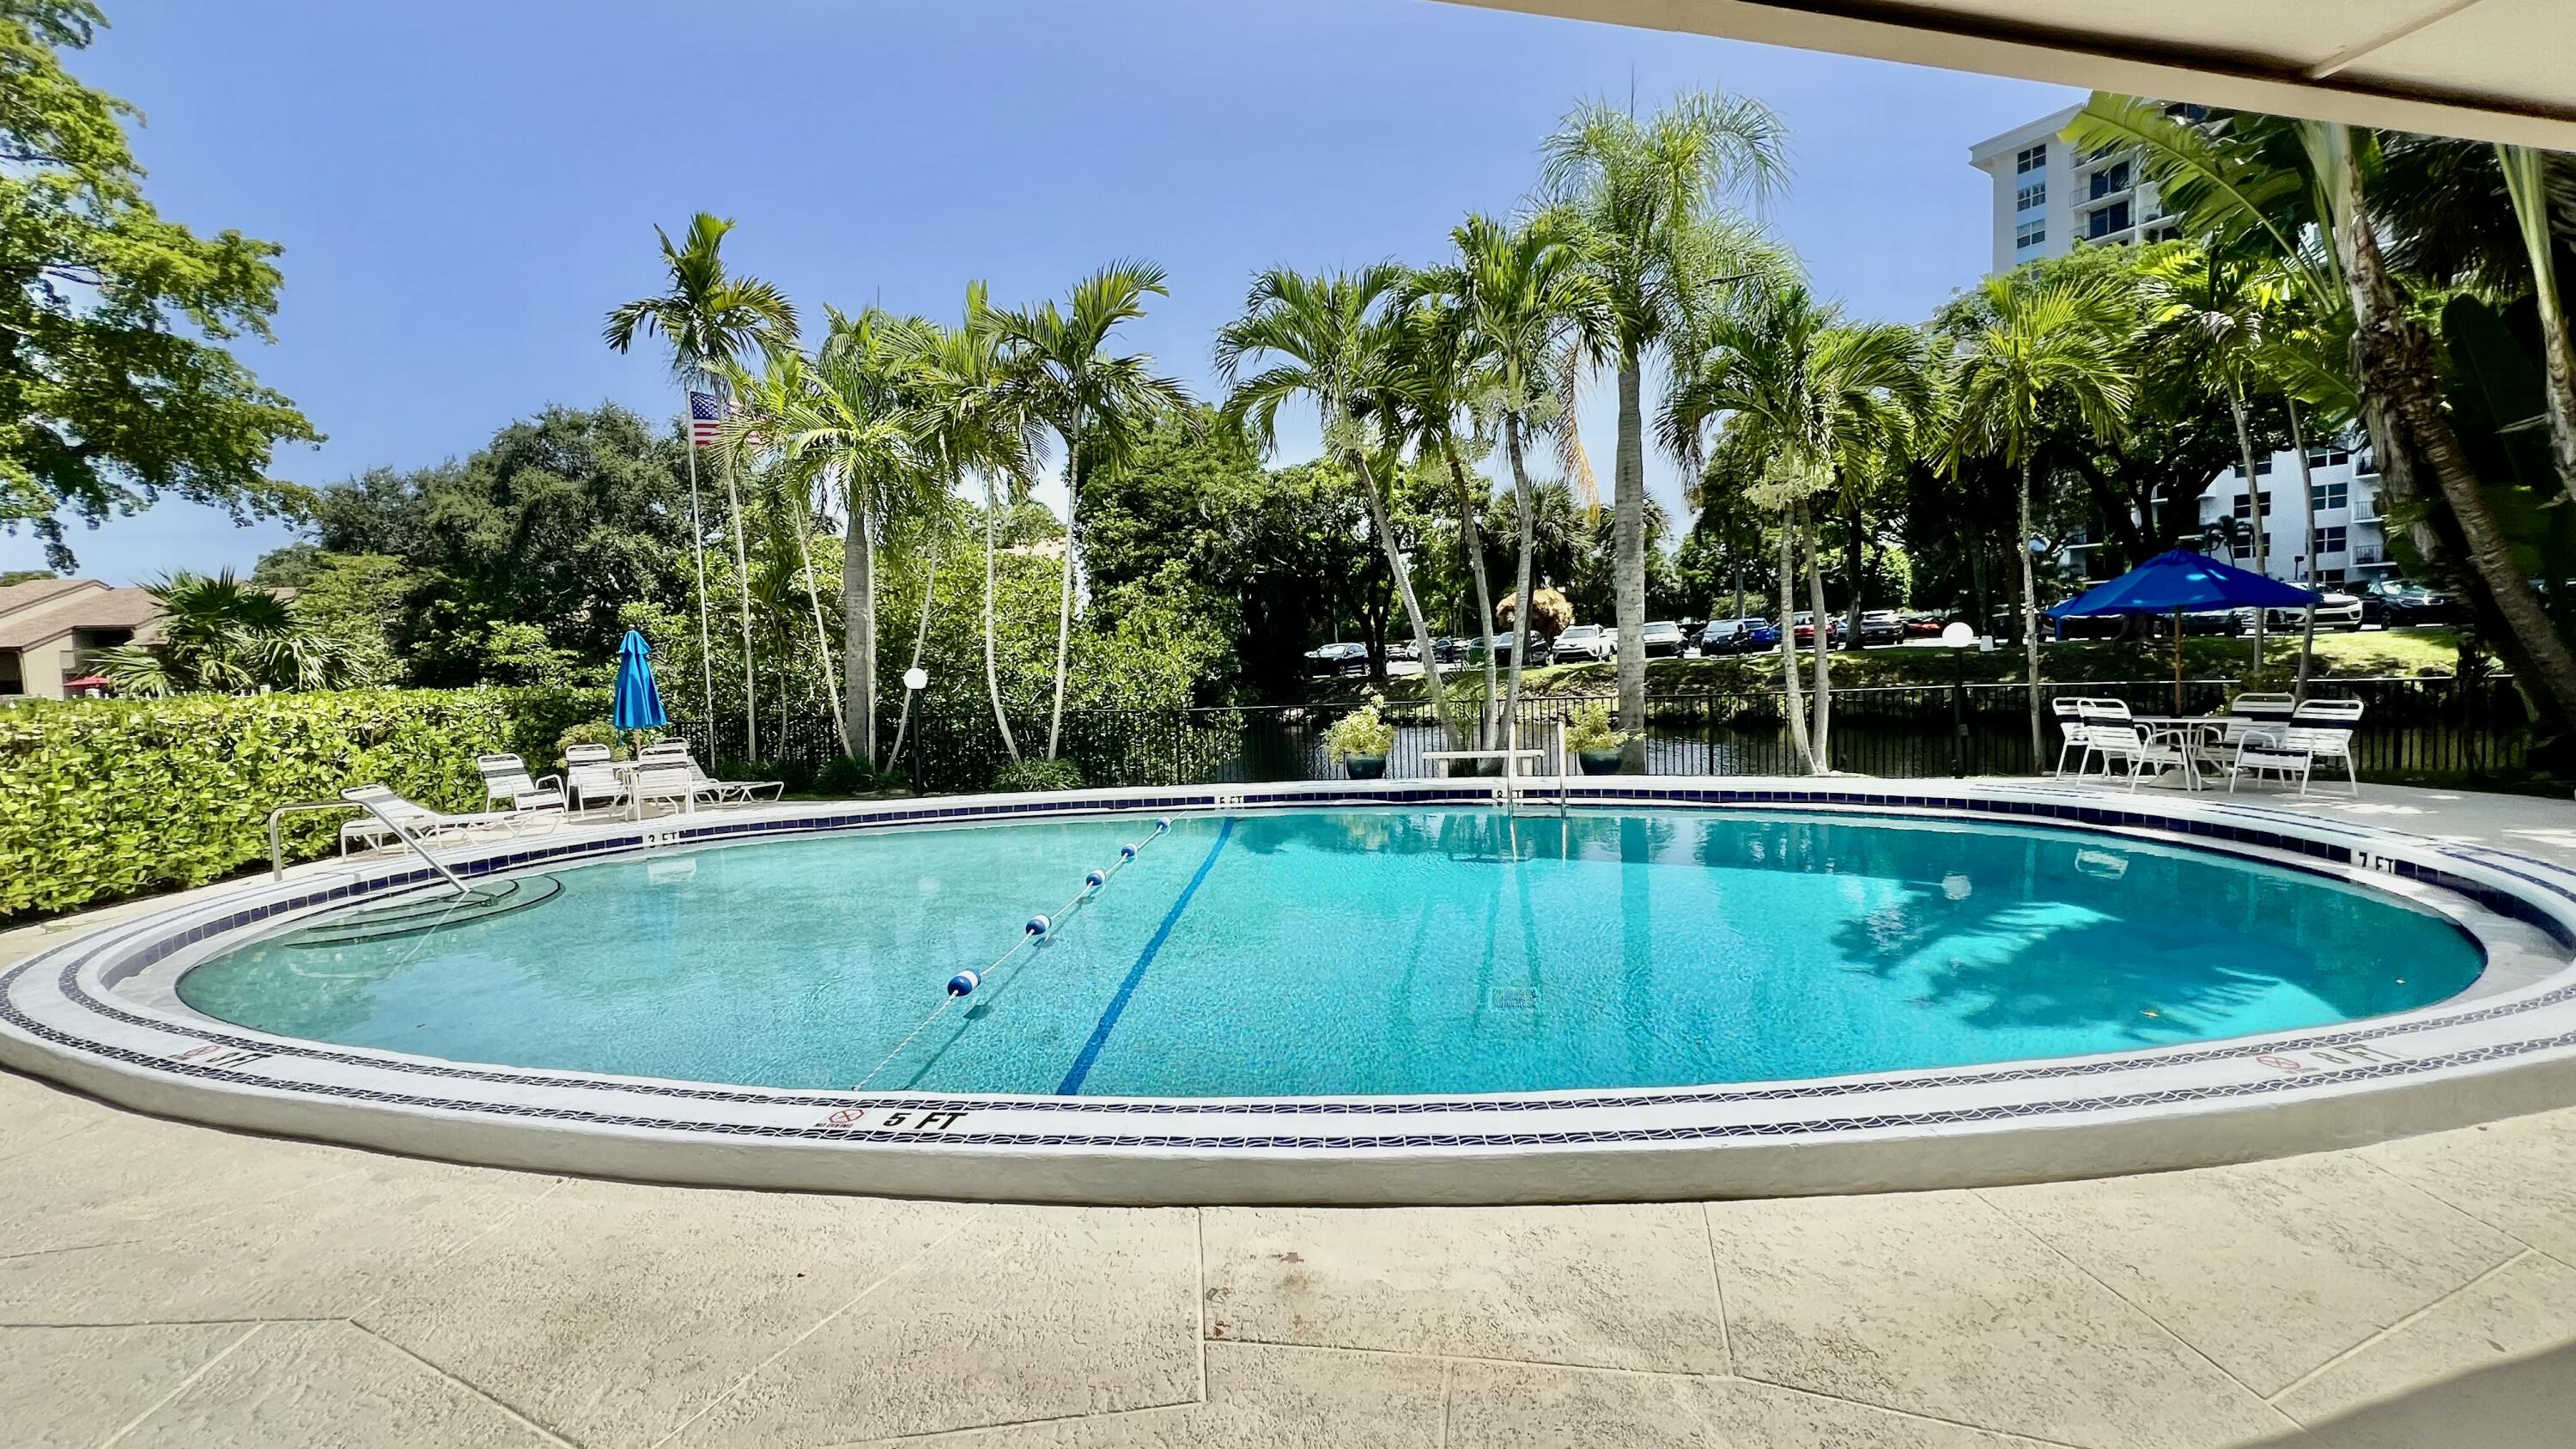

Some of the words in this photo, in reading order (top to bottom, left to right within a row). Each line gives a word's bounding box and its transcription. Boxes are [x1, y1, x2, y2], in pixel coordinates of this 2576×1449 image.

[2358, 851, 2368, 868] 7
[2375, 855, 2394, 874] FT
[215, 1053, 273, 1068] FT
[2309, 1051, 2352, 1065] 8
[2331, 1044, 2401, 1062] FT
[882, 1112, 912, 1127] 5
[913, 1111, 969, 1130] FT
